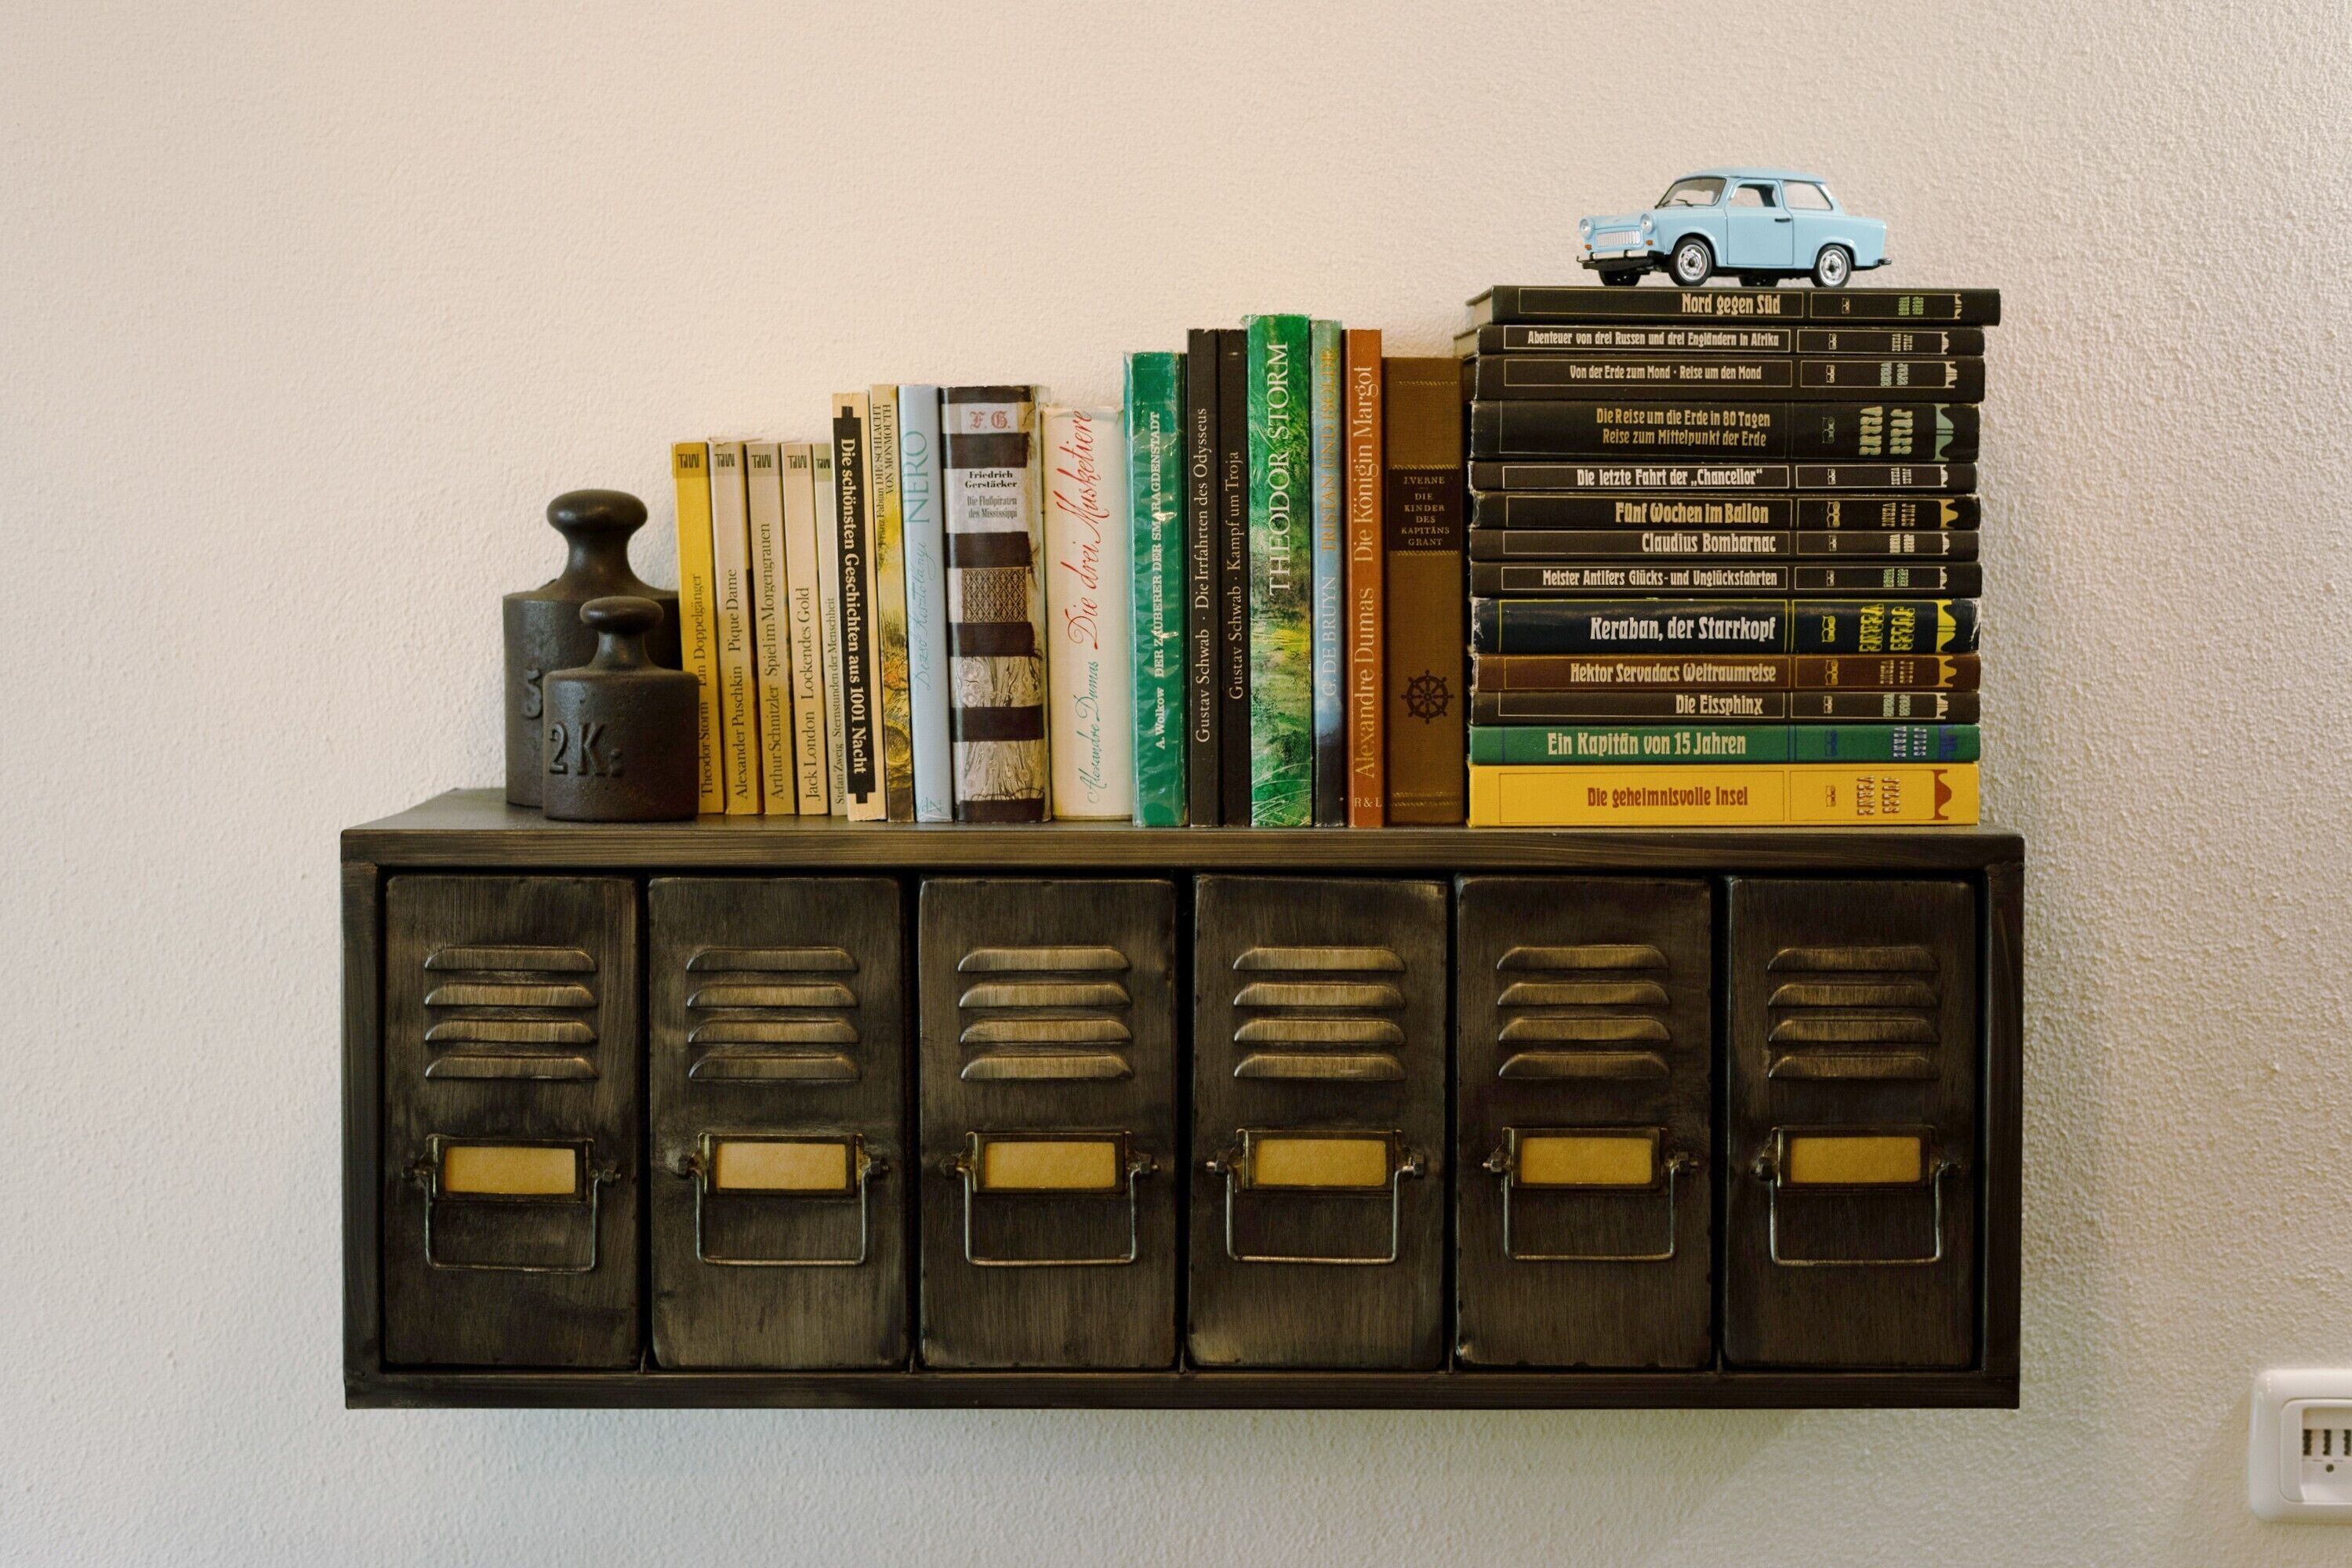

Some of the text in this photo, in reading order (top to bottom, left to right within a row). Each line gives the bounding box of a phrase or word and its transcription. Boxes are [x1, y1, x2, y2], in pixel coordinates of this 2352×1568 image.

[1682, 293, 1780, 315] Nord gegen Süd
[1527, 330, 1779, 348] Abenteuer von drei Russen und drei Engländern in Afrika
[1570, 365, 1762, 379] Von der Erde zum Mond Reise um den Mond
[873, 404, 882, 464] SCHLACHT
[1596, 408, 1770, 429] Die Reise um die Erde in 80 Tagen
[883, 405, 893, 472] MONMOUTH
[1320, 424, 1335, 469] UND
[1602, 428, 1766, 447] Reise zum Mittelpunkt der Erde
[875, 466, 884, 485] DIE
[902, 431, 929, 523] NERO
[965, 480, 1018, 488] Gerstäcker
[969, 470, 1013, 479] Friedrich
[1267, 342, 1290, 596] THEODOR STORM
[1577, 469, 1595, 486] Die
[1599, 469, 1632, 486] letzte
[1635, 468, 1667, 486] Fahrt
[1670, 469, 1688, 486] der
[876, 487, 884, 517] Fabian
[967, 495, 978, 506] Die
[968, 509, 1017, 519] des Mississippi
[1321, 475, 1335, 552] TRISTAN
[1615, 502, 1769, 524] Fünf Wochen im Ballon
[1053, 411, 1109, 650] Die drei Musketiere
[1642, 533, 1777, 553] Claudius Bombarnac
[1150, 412, 1164, 735] Wolkow DER ZAUBERER DER SMARAGDENSTADT
[1192, 408, 1212, 743] Gustav Schwab Die Irrfahrten des Odysseus
[1225, 452, 1244, 700] Gustav Schwab Kampf um Troja
[1353, 366, 1379, 778] Alexandre Dumas Die Königin Margot
[1542, 570, 1580, 586] Meister
[1583, 570, 1625, 586] Antifers
[1670, 571, 1690, 586] und
[1692, 570, 1777, 588] Unglücksfahrten
[691, 575, 706, 659] Doppelgänger
[841, 438, 868, 774] Die schönsten Geschichten aus 1001 Nacht
[1322, 576, 1336, 641] BRUYN
[1590, 617, 1777, 643] Keraban, der Starrkopf
[760, 523, 784, 800] Arthur Schnitzler Spiel im Morgengrauen
[1322, 648, 1336, 672] DE
[1570, 662, 1777, 682] Hektor Servadacs Weltraumreise
[727, 569, 748, 800] Alexander Puschkin Pique Dame
[795, 587, 820, 800] Jack London Lockendes Gold
[826, 597, 845, 804] Stefan Zweig Sternstunden der Menschheit
[699, 702, 711, 740] Storm
[1675, 694, 1763, 716] Die Eissphinx
[1073, 661, 1107, 804] Alexandre Dumas
[1547, 732, 1746, 757] Ein Kapitän von 15 Jahren
[1893, 726, 1907, 757] VERNE
[1913, 728, 1927, 757] JULES
[699, 742, 713, 797] Theodor
[1588, 786, 1748, 808] Die geheimnisvolle Insel
[1857, 775, 1875, 816] VERNE
[1882, 778, 1900, 814] JULES
